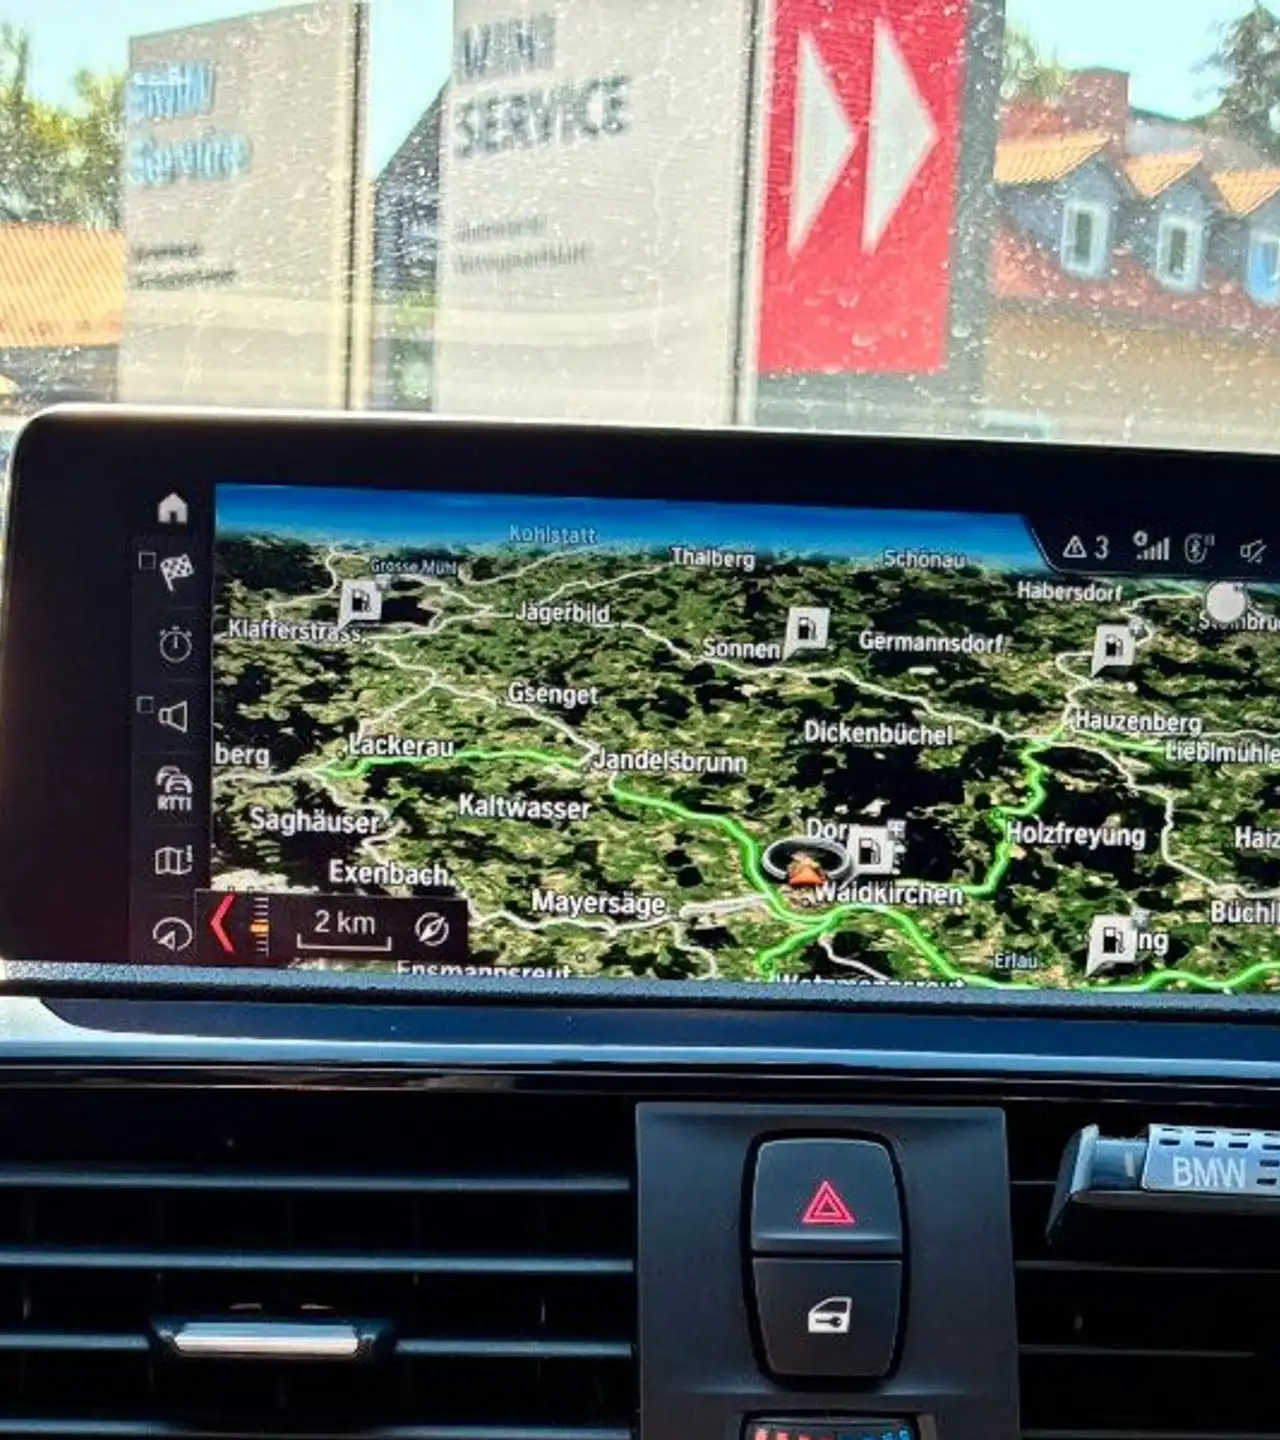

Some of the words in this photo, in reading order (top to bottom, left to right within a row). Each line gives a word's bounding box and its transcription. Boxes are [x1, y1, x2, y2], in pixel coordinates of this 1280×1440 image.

[509, 523, 598, 545] Kohlstatt
[670, 547, 755, 570] Thalberg
[1094, 535, 1110, 560] 3
[371, 558, 419, 575] Grosse
[1017, 580, 1123, 602] Habersdorf
[515, 599, 611, 626] Jägerbild
[704, 639, 781, 659] Sonnen
[858, 631, 1003, 655] Germannsdorf
[508, 683, 598, 708] Gsenget
[804, 720, 954, 746] Dickenbüchel
[1076, 711, 1203, 737] Hauzenberg
[349, 734, 454, 758] Lackerau
[593, 751, 748, 775] Jandelsbrunn
[156, 794, 193, 811] RTTI
[459, 794, 591, 820] Kaltwasser
[249, 808, 380, 837] Saghäuser
[1007, 822, 1147, 851] Holzfreyung
[328, 860, 450, 888] Exenbach
[530, 890, 666, 917] Mayersäge
[314, 910, 330, 933] 2
[337, 909, 376, 934] km
[994, 952, 1038, 969] Erlau
[1172, 1156, 1247, 1189] BMW
